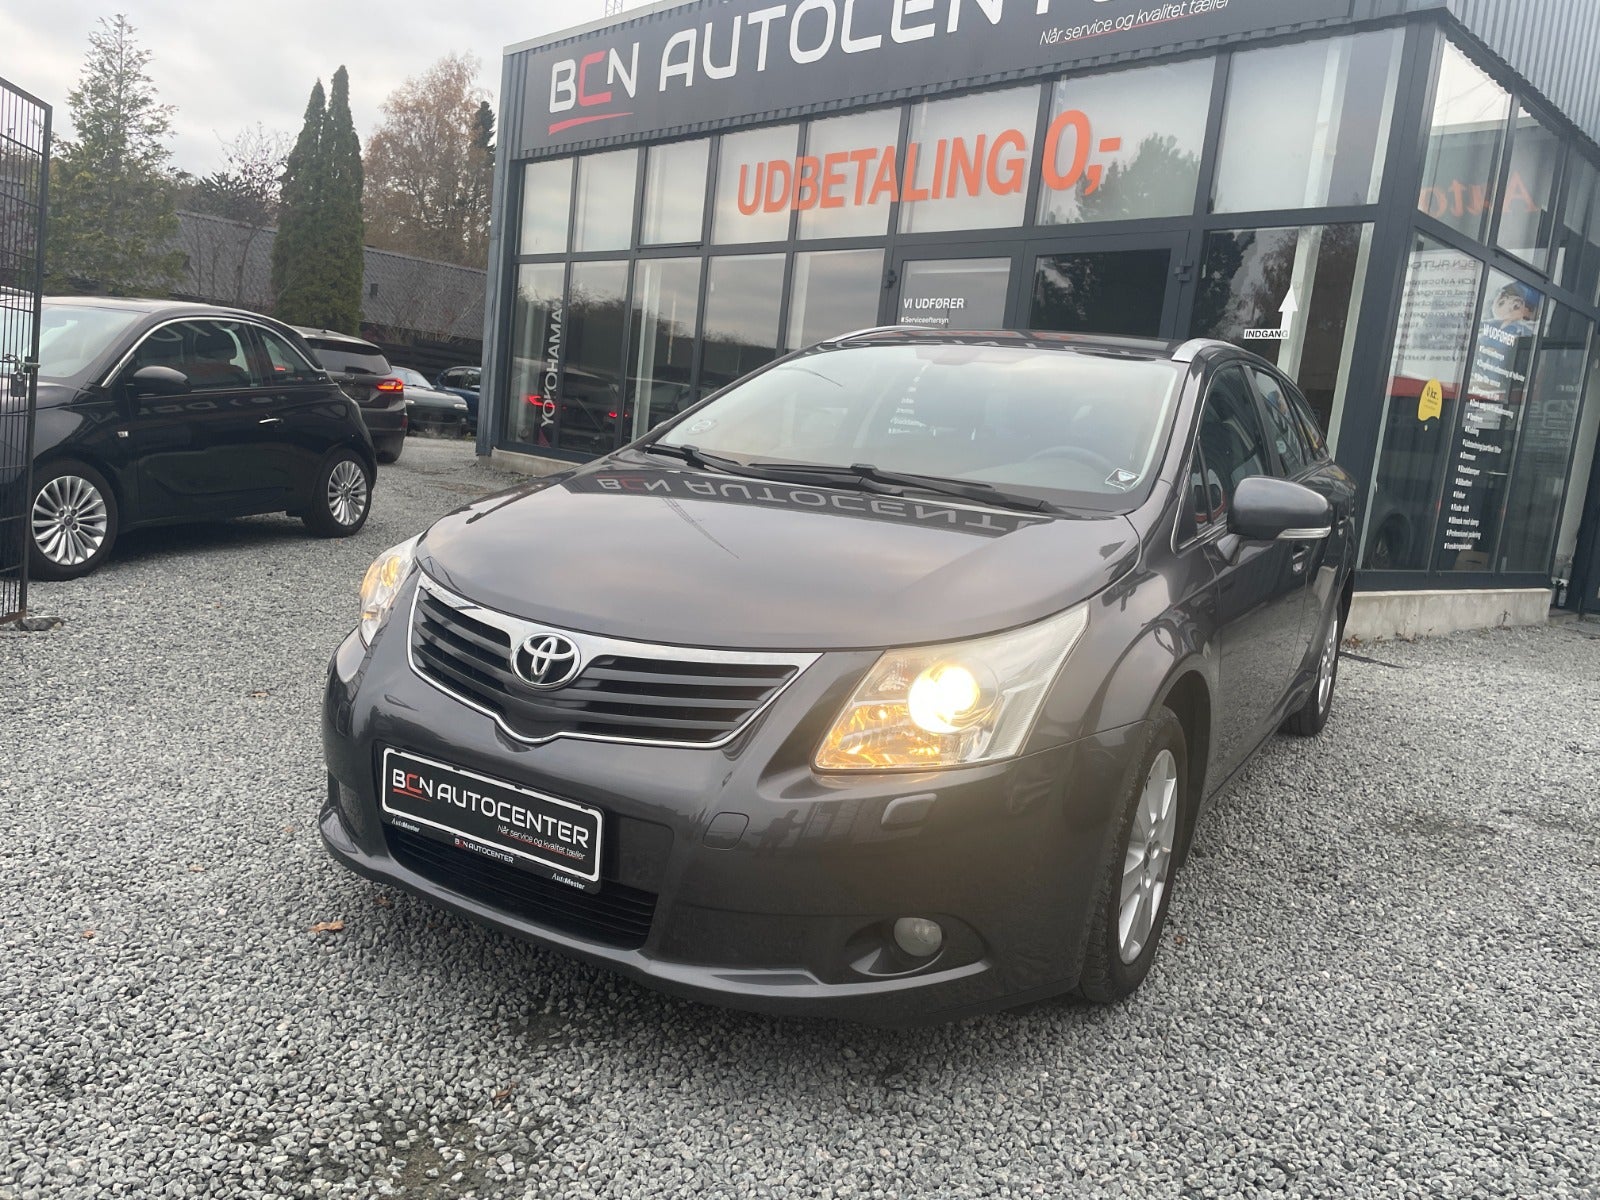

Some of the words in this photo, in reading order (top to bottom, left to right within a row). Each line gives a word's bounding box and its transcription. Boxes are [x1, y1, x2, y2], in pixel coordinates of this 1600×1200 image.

[1039, 27, 1061, 45] Når
[1064, 19, 1113, 40] service
[1115, 15, 1133, 31] og
[1136, 1, 1186, 25] kvalitet
[549, 42, 639, 113] BCN
[737, 129, 1027, 216] UDBETALING
[1041, 110, 1121, 196] 0,-
[903, 299, 912, 309] VI
[915, 298, 965, 310] UDFØRER
[1244, 329, 1289, 339] INDGANG
[541, 307, 563, 427] YOKOHAMA
[393, 768, 434, 798] BCN
[437, 783, 589, 849] AUTOCENTER
[454, 838, 468, 848] BCN
[468, 843, 514, 864] AUTOCENTER
[497, 824, 508, 834] Når
[510, 828, 533, 842] service
[533, 837, 542, 848] og
[544, 840, 566, 854] kvalitet
[566, 848, 586, 860] tæller
[551, 872, 585, 890] AutoMester
